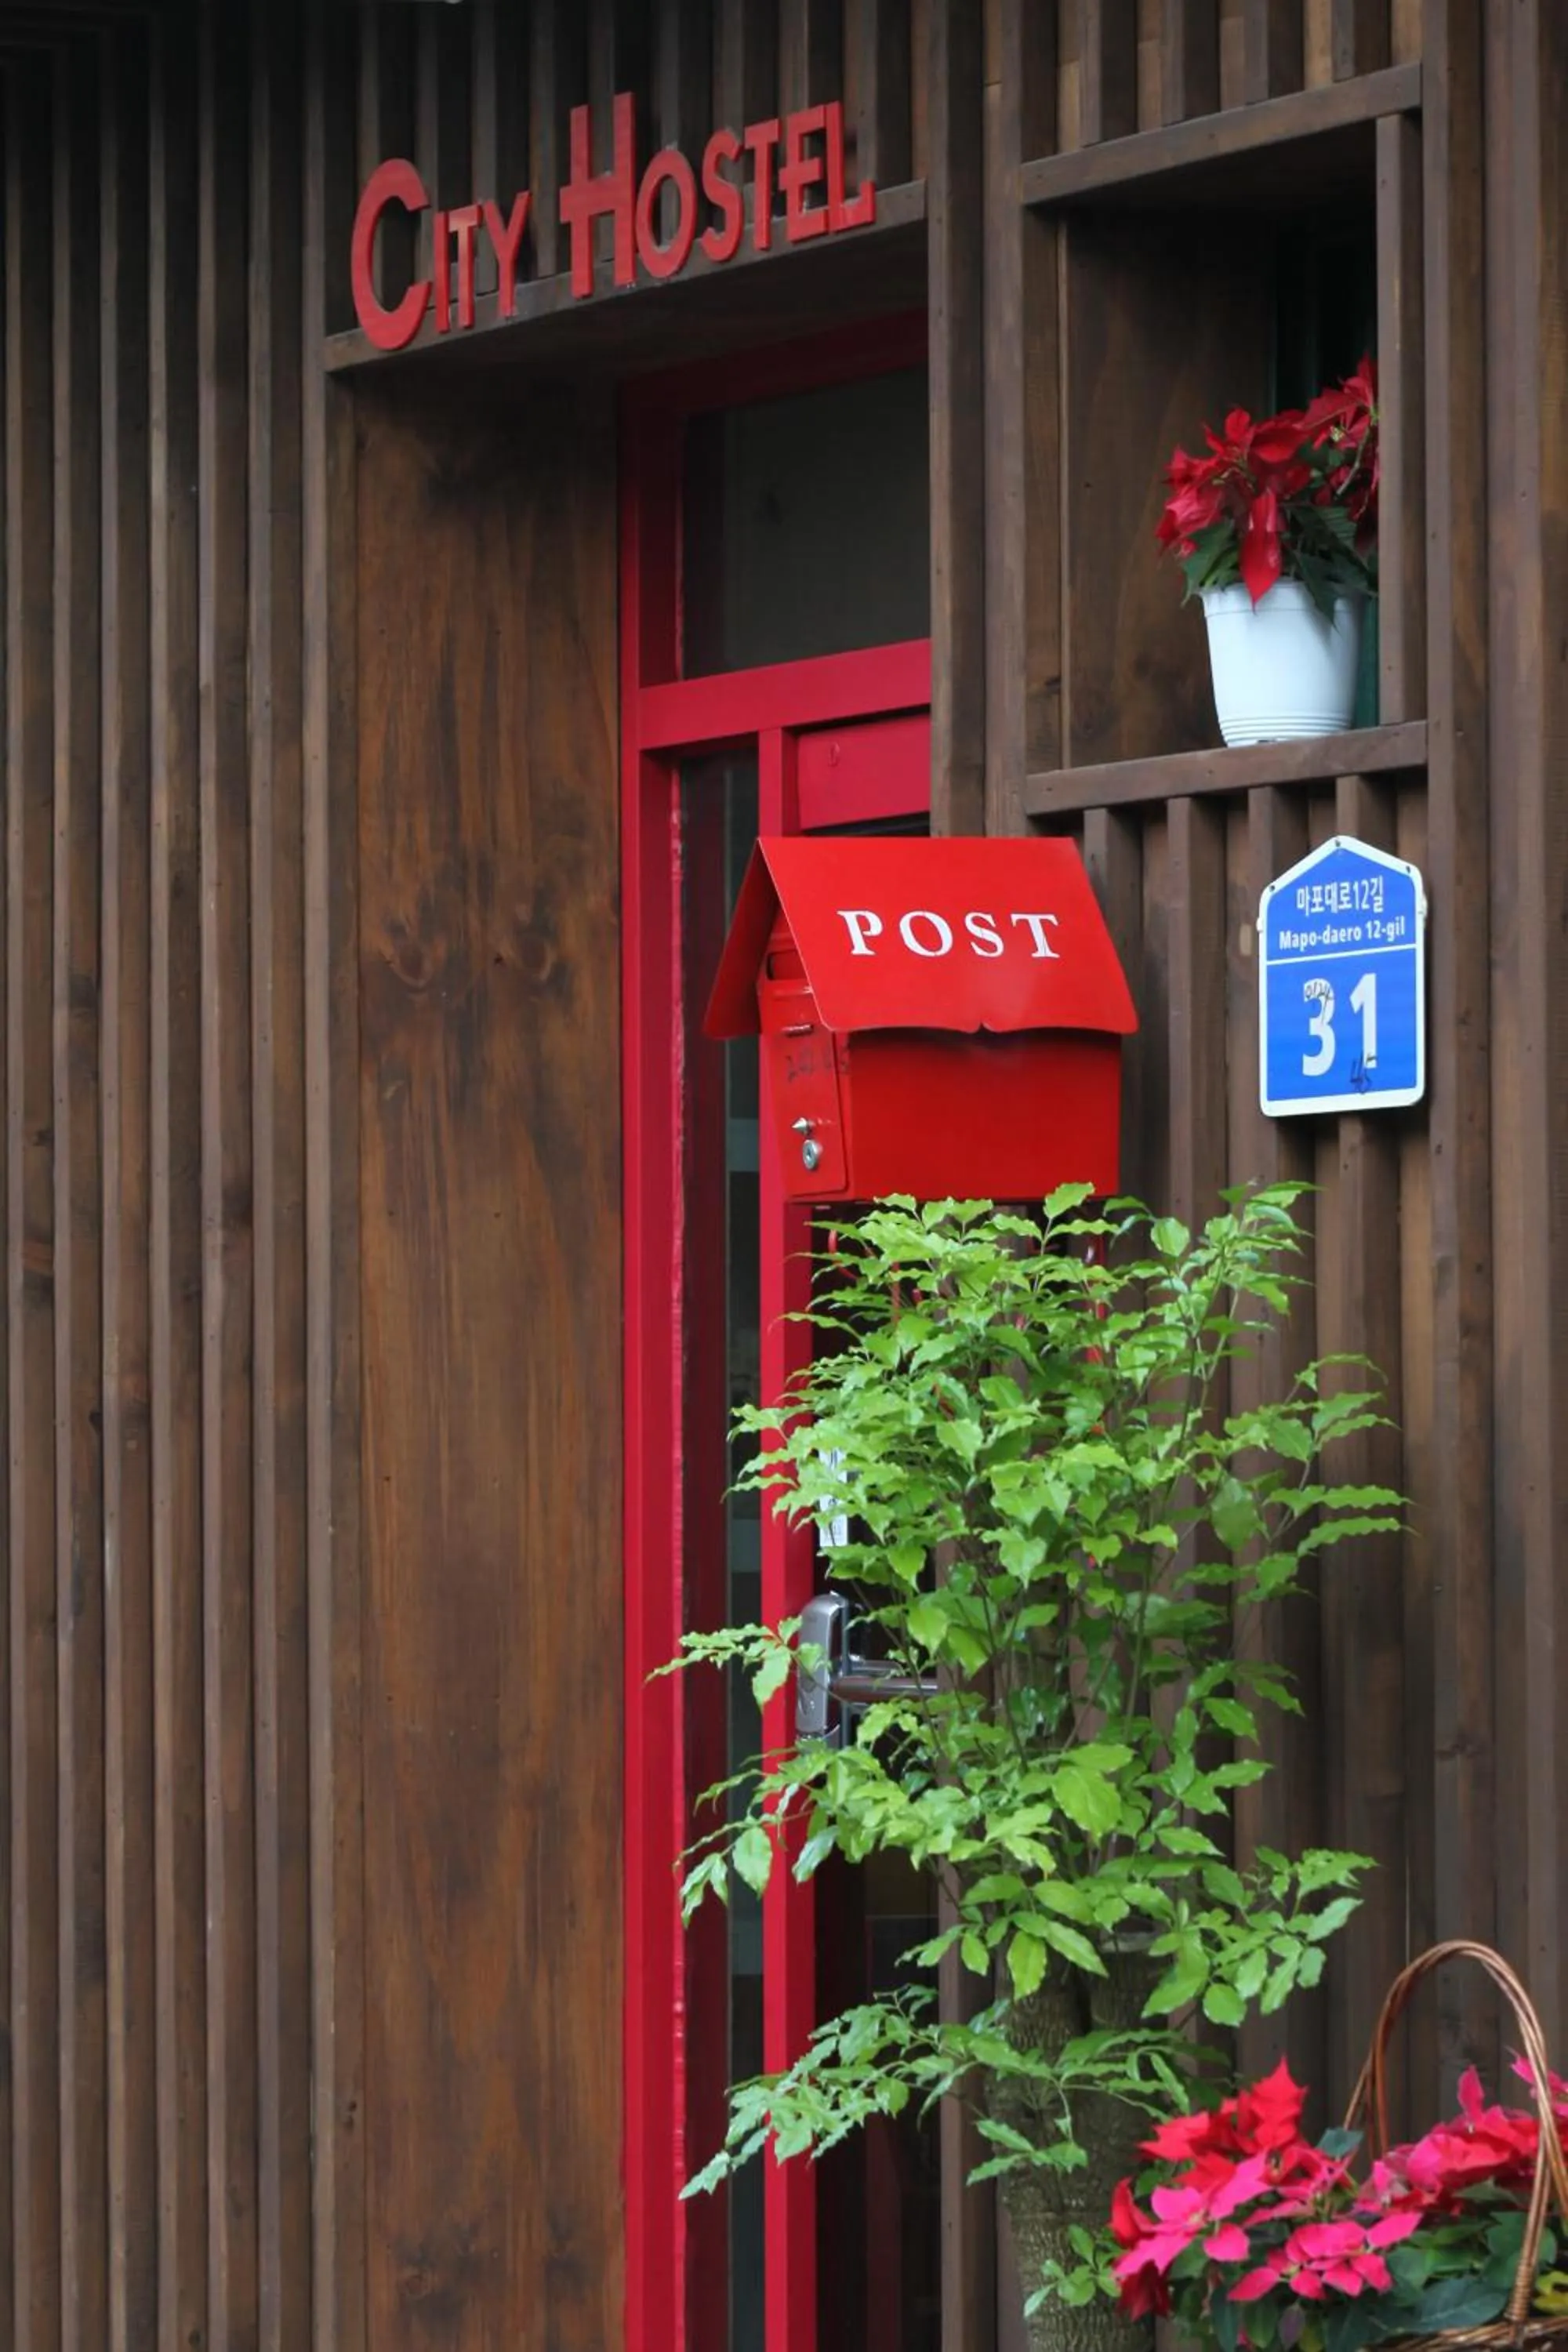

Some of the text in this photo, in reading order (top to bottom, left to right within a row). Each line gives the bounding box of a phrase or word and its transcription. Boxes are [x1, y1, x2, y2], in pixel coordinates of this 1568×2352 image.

[1296, 875, 1384, 916] 마포대로12길
[837, 909, 1060, 959] POST
[1279, 915, 1406, 951] Mapo-daero 12-gil
[1302, 973, 1377, 1076] 31
